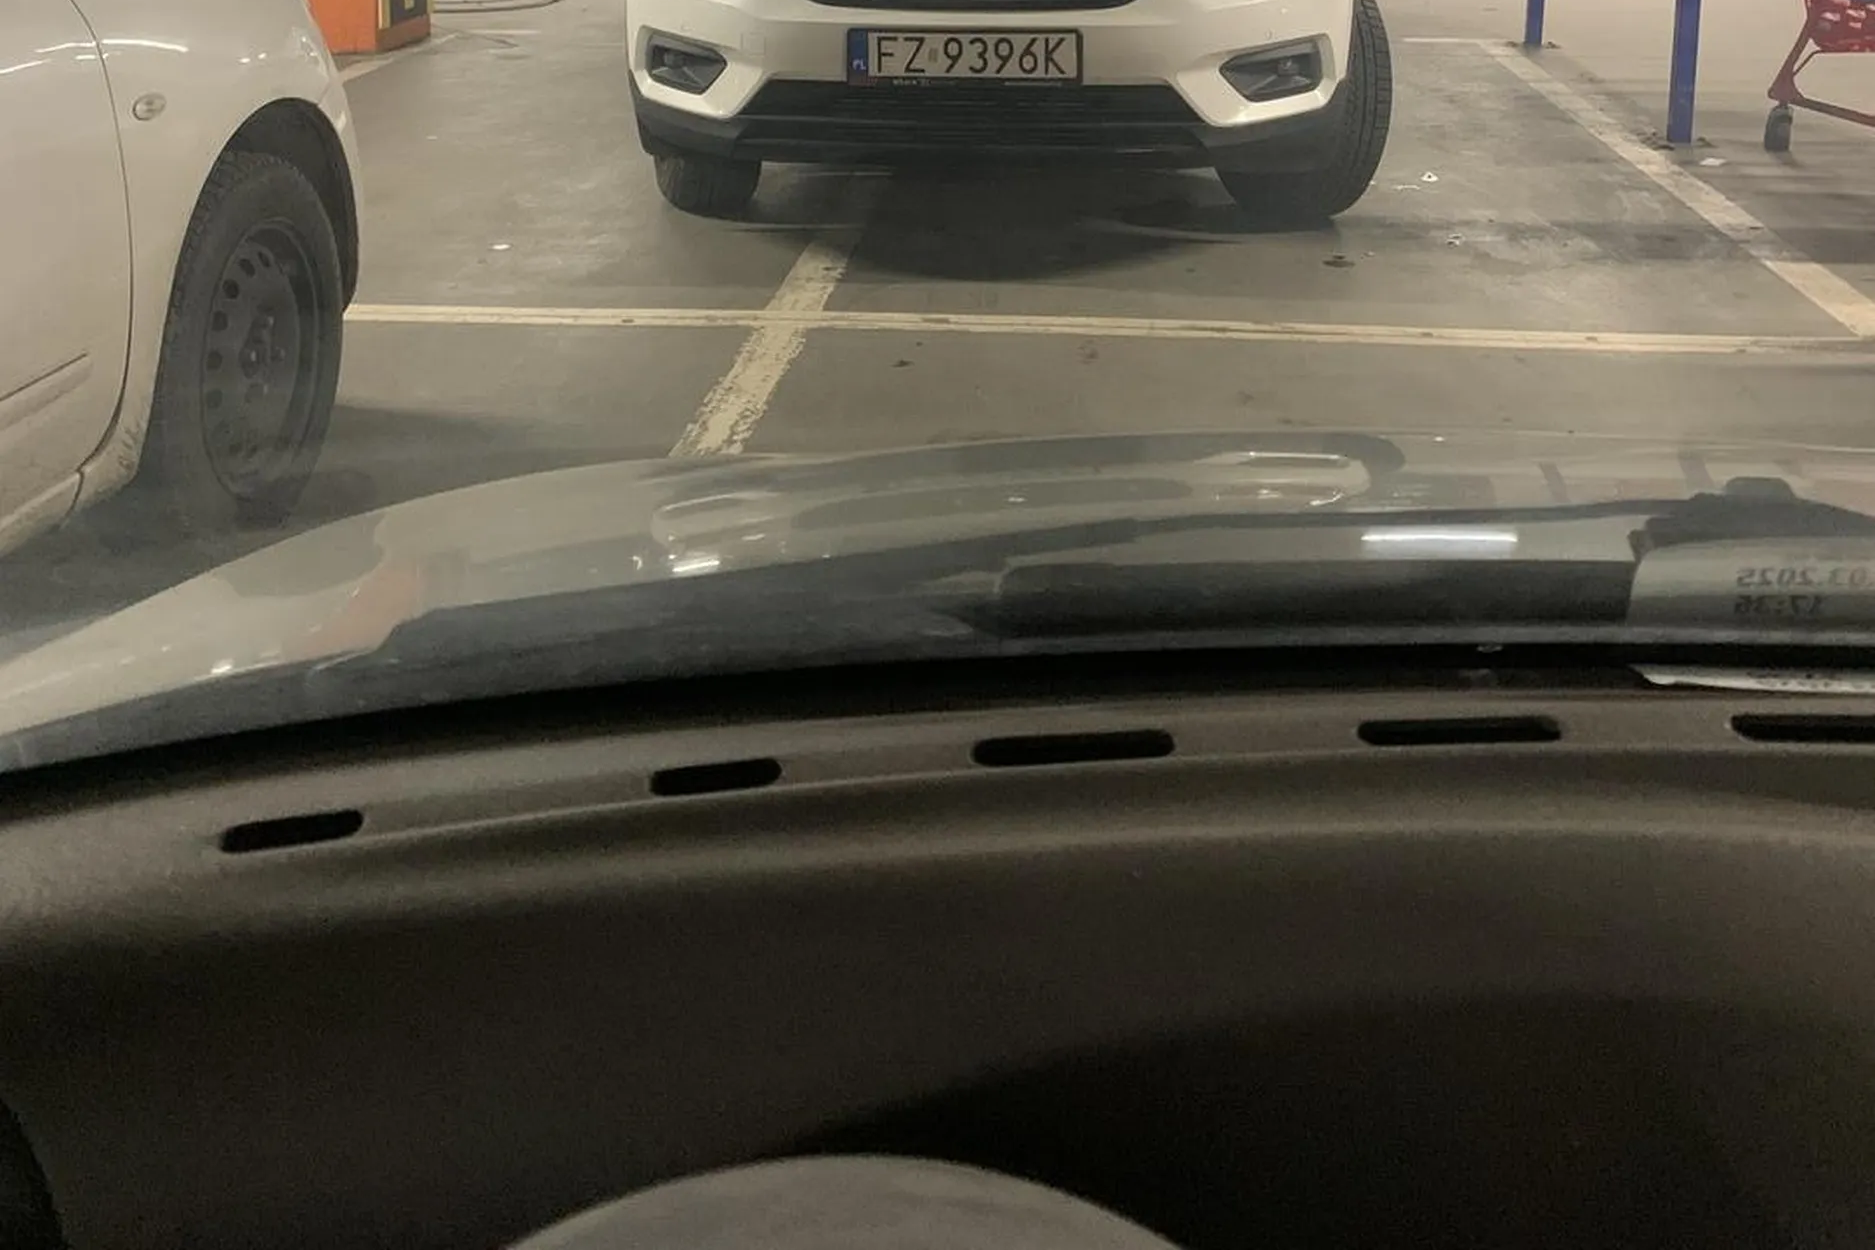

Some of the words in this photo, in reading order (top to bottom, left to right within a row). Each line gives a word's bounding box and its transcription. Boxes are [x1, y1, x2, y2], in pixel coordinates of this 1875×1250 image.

[852, 60, 867, 71] PL
[876, 36, 926, 74] FZ
[942, 36, 1067, 75] 9396K
